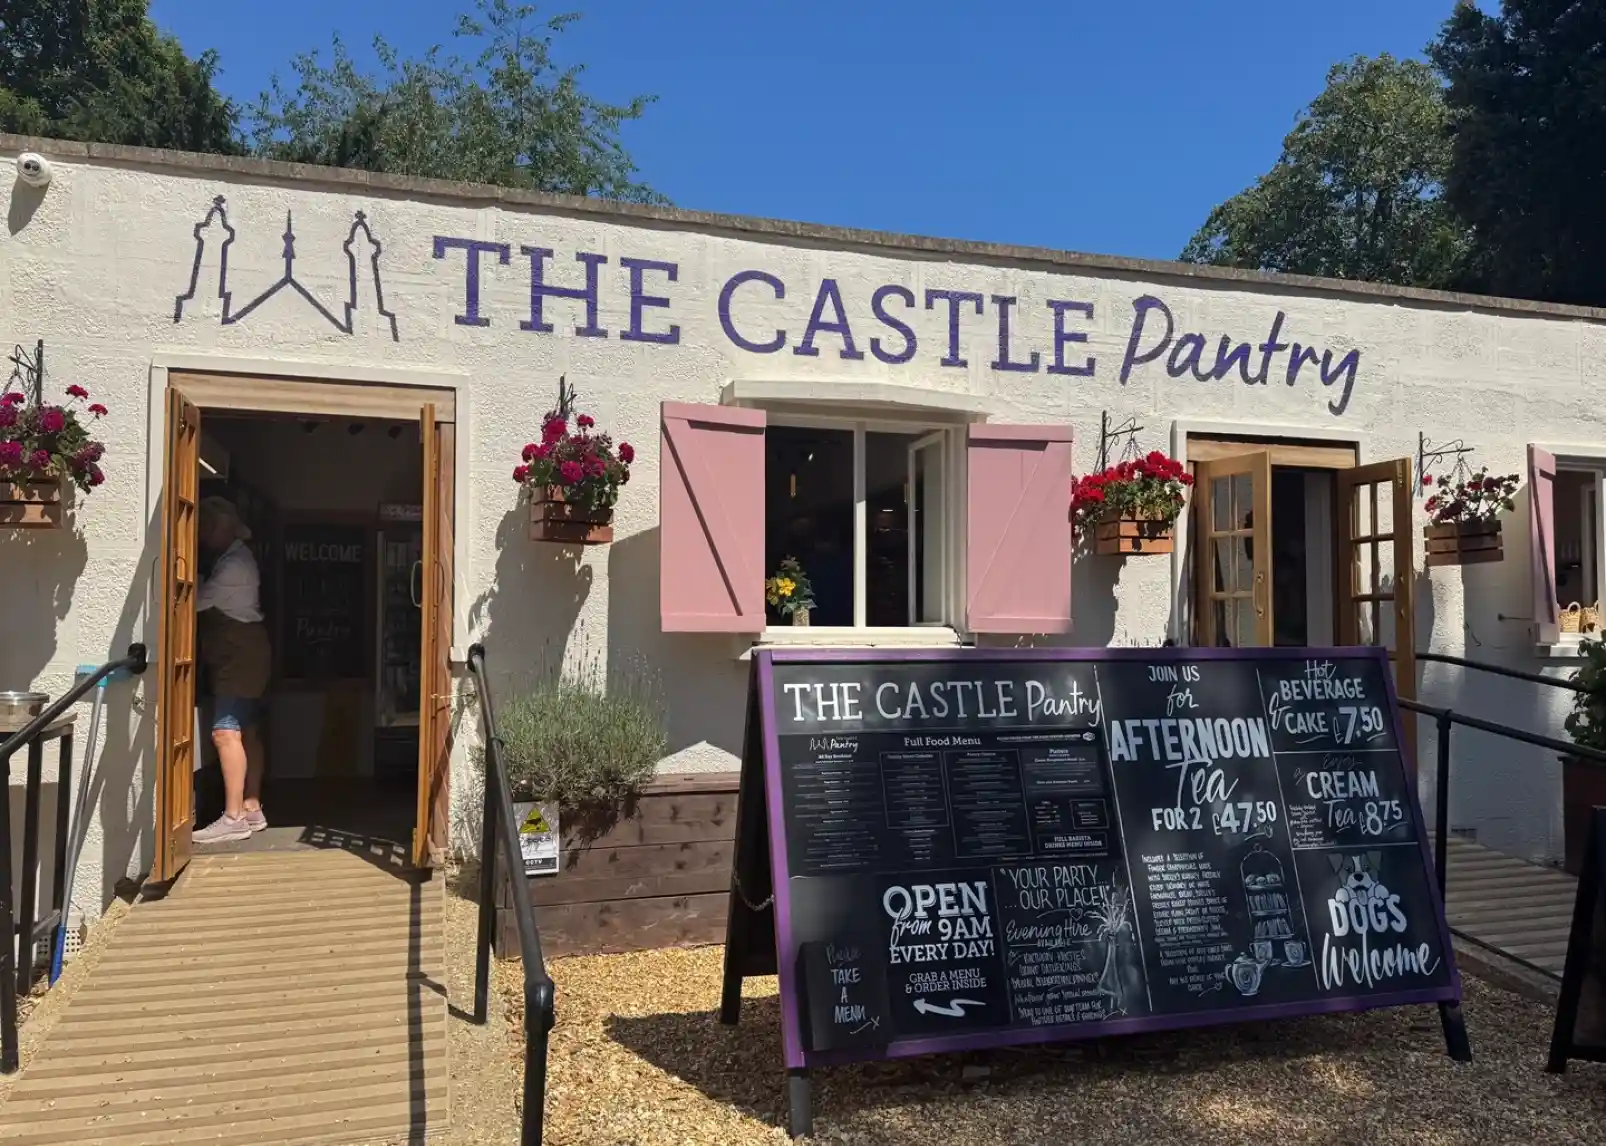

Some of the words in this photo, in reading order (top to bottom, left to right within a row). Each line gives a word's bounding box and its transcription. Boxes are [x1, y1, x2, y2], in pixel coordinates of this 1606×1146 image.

[432, 235, 681, 345] THE
[717, 270, 1096, 378] CASTLE
[1119, 294, 1361, 416] Pantry
[285, 543, 362, 562] WELCOME
[1148, 665, 1178, 682] JOIN
[1183, 665, 1200, 681] US
[1304, 660, 1337, 680] Hot
[1166, 686, 1199, 717] for
[1280, 678, 1365, 701] BEVERAGE
[783, 682, 863, 721] THE
[875, 681, 1018, 720] CASTLE
[1025, 680, 1102, 727] Pantry
[1285, 711, 1329, 734] CAKE
[1333, 706, 1384, 744] £7.50
[830, 738, 859, 752] Pantry
[903, 737, 923, 747] Full
[925, 736, 950, 746] Food
[953, 736, 982, 746] Menu
[1111, 716, 1270, 762] AFTERNOON
[1165, 757, 1239, 808] Tea
[1306, 771, 1379, 799] CREAM
[1151, 808, 1185, 832] FOR
[1190, 807, 1203, 830] 2
[1213, 801, 1277, 836] £47.50
[1322, 799, 1357, 829] Tea
[1359, 800, 1403, 835] £8.75
[883, 881, 987, 919] OPEN
[890, 908, 931, 947] from
[938, 917, 993, 940] 9AM
[1328, 895, 1407, 937] DOGS
[1005, 918, 1063, 942] Evening
[1064, 917, 1093, 938] Hire
[890, 944, 948, 965] EVERY
[954, 940, 995, 958] DAY!
[1321, 931, 1441, 990] Welcome
[831, 968, 861, 985] TAKE
[905, 983, 912, 994] &
[914, 980, 950, 993] ORDER
[952, 977, 986, 990] INSIDE
[909, 972, 936, 984] GRAB
[937, 971, 946, 982] A
[949, 968, 980, 981] MENU
[840, 986, 848, 1003] A
[834, 1005, 866, 1024] MENU
